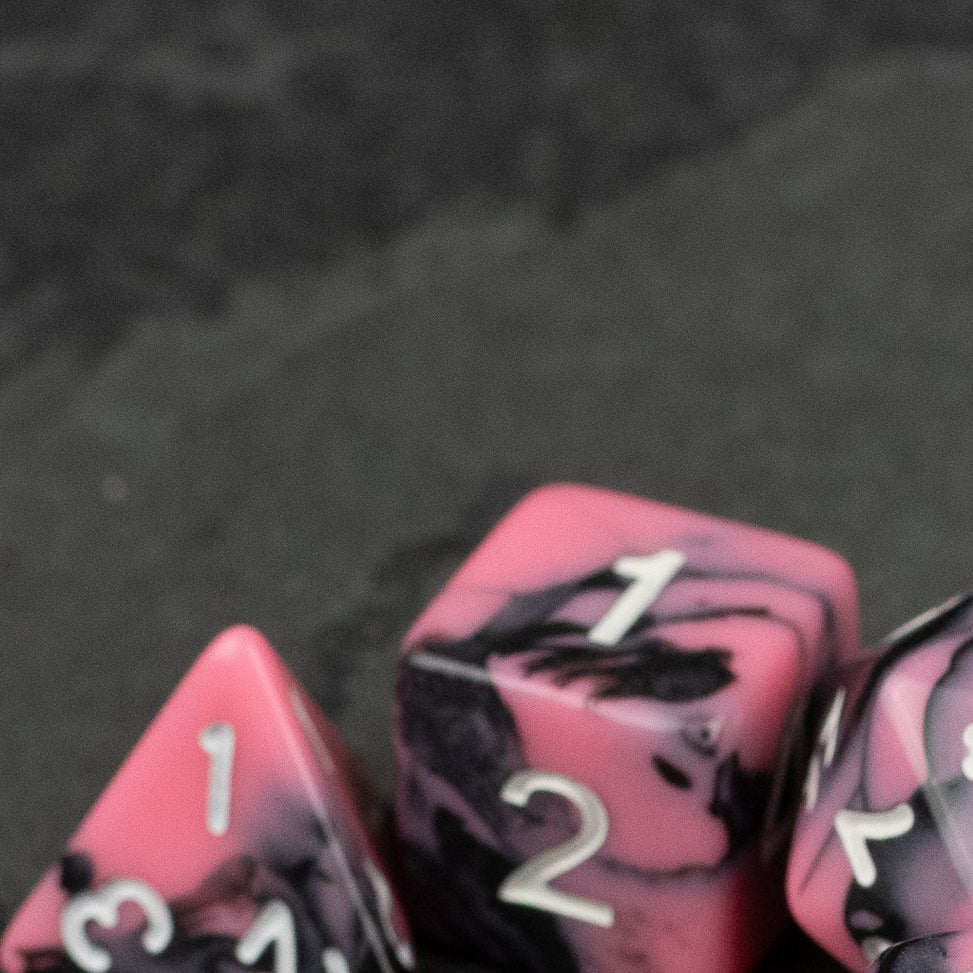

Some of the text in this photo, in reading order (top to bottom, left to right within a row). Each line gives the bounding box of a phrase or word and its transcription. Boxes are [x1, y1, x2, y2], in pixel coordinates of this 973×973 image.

[589, 550, 687, 647] 1
[200, 723, 235, 835] 1
[498, 770, 615, 928] 2
[60, 878, 172, 973] 3
